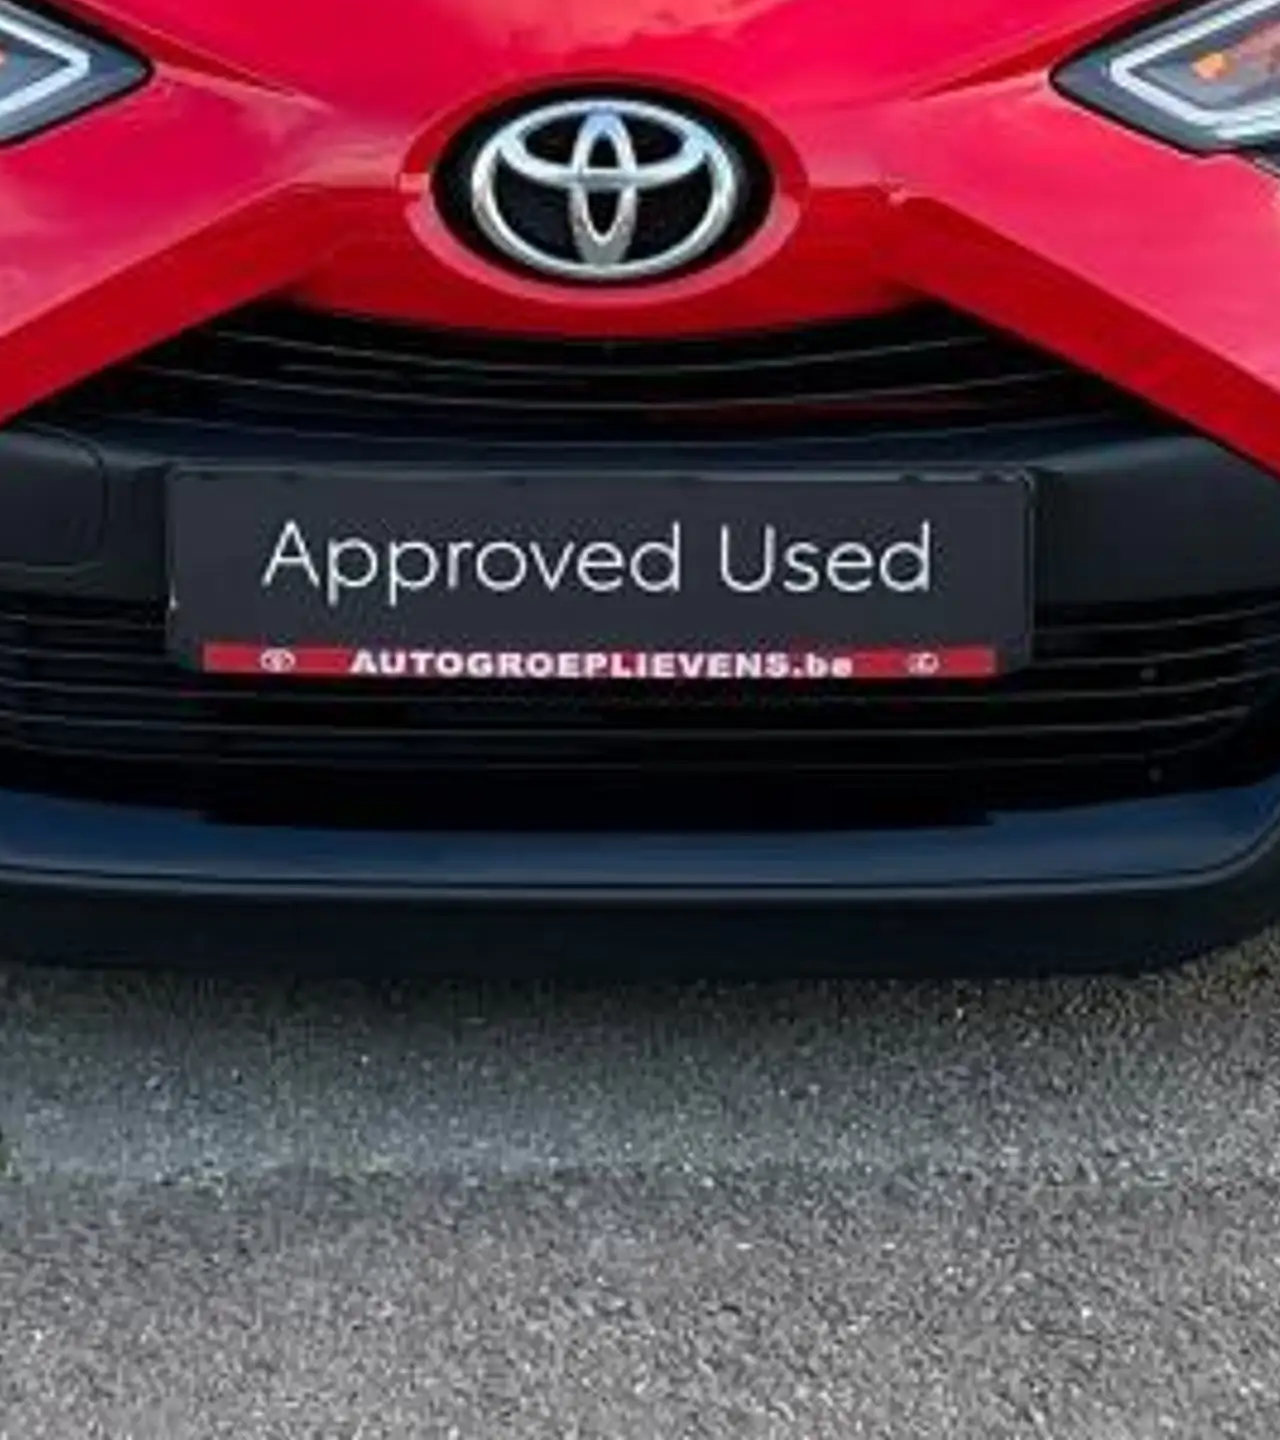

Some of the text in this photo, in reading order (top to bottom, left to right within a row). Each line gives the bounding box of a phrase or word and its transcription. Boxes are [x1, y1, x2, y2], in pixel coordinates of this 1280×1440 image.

[261, 518, 931, 607] Approved Used
[348, 649, 855, 679] AUTOGROEPLIEVENS.be
